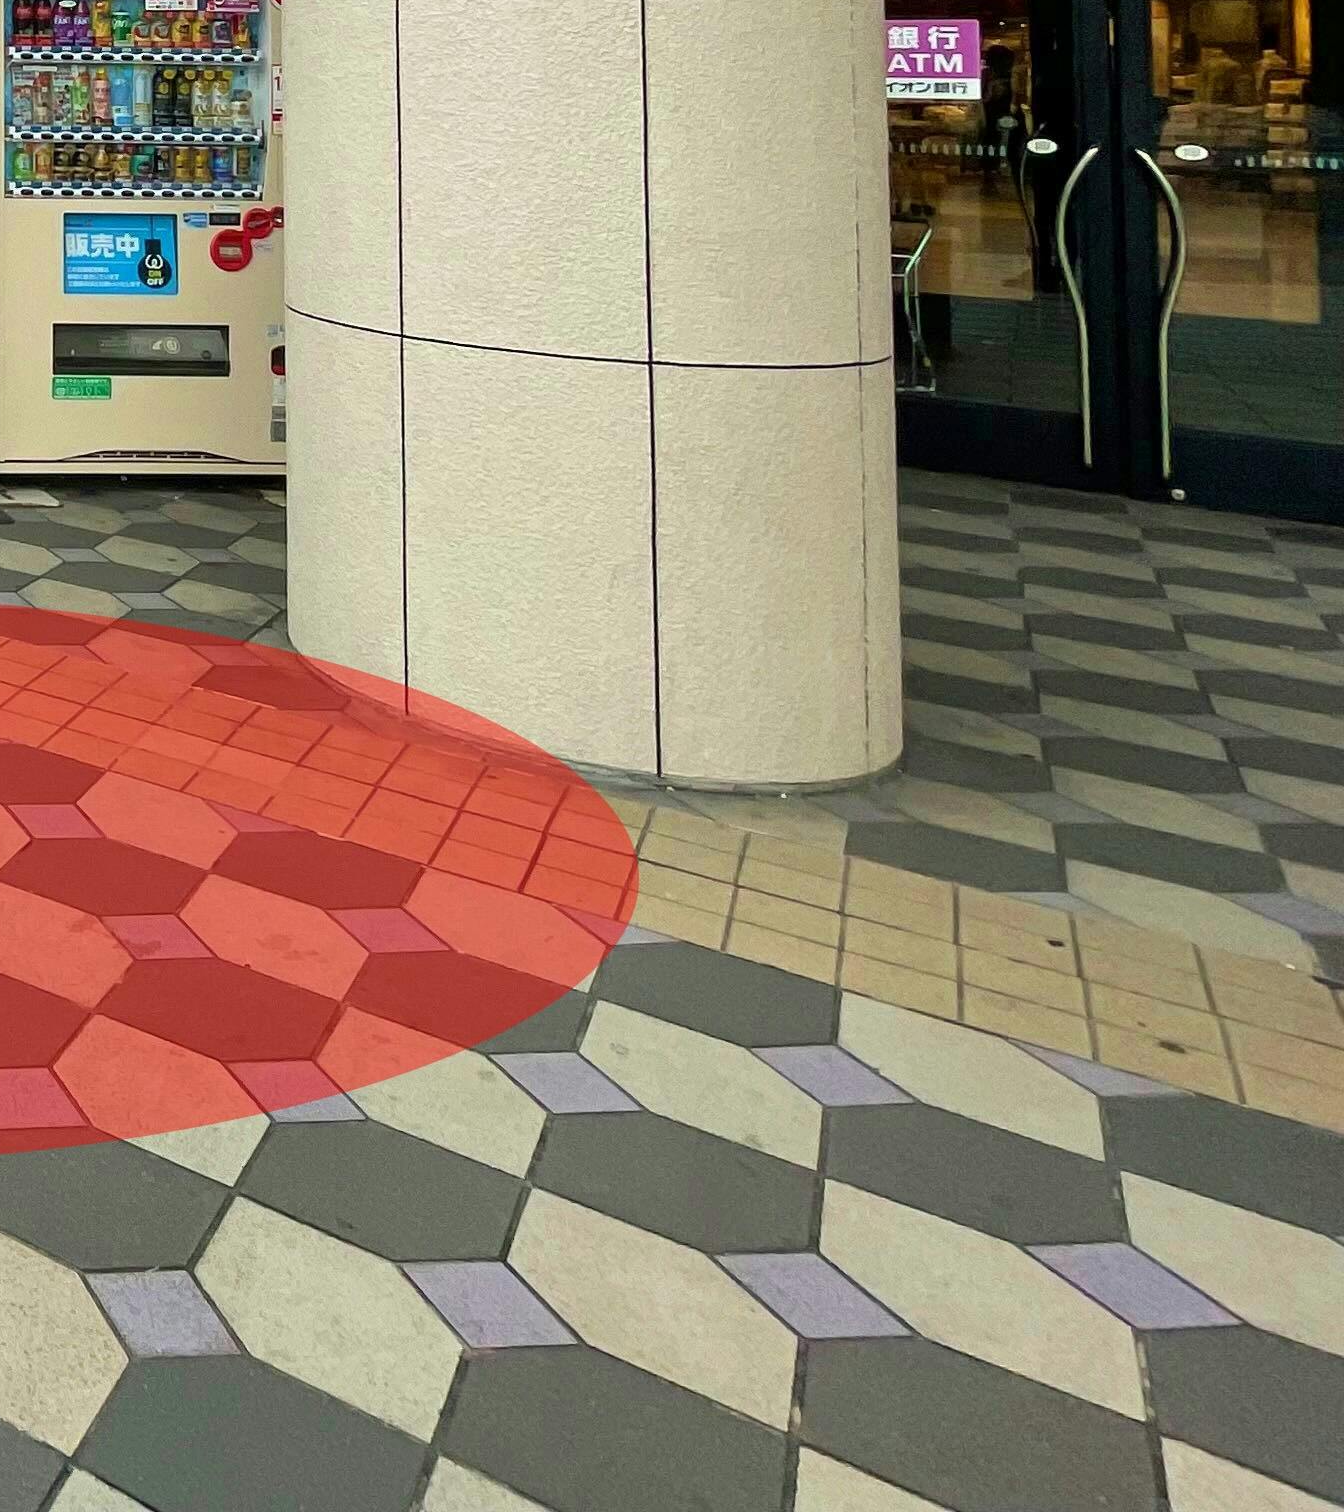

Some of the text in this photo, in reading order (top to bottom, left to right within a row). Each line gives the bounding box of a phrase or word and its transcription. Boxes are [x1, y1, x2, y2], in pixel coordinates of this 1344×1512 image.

[887, 53, 964, 74] ATM
[886, 81, 968, 94] イオン銀行
[65, 232, 140, 259] 販売中
